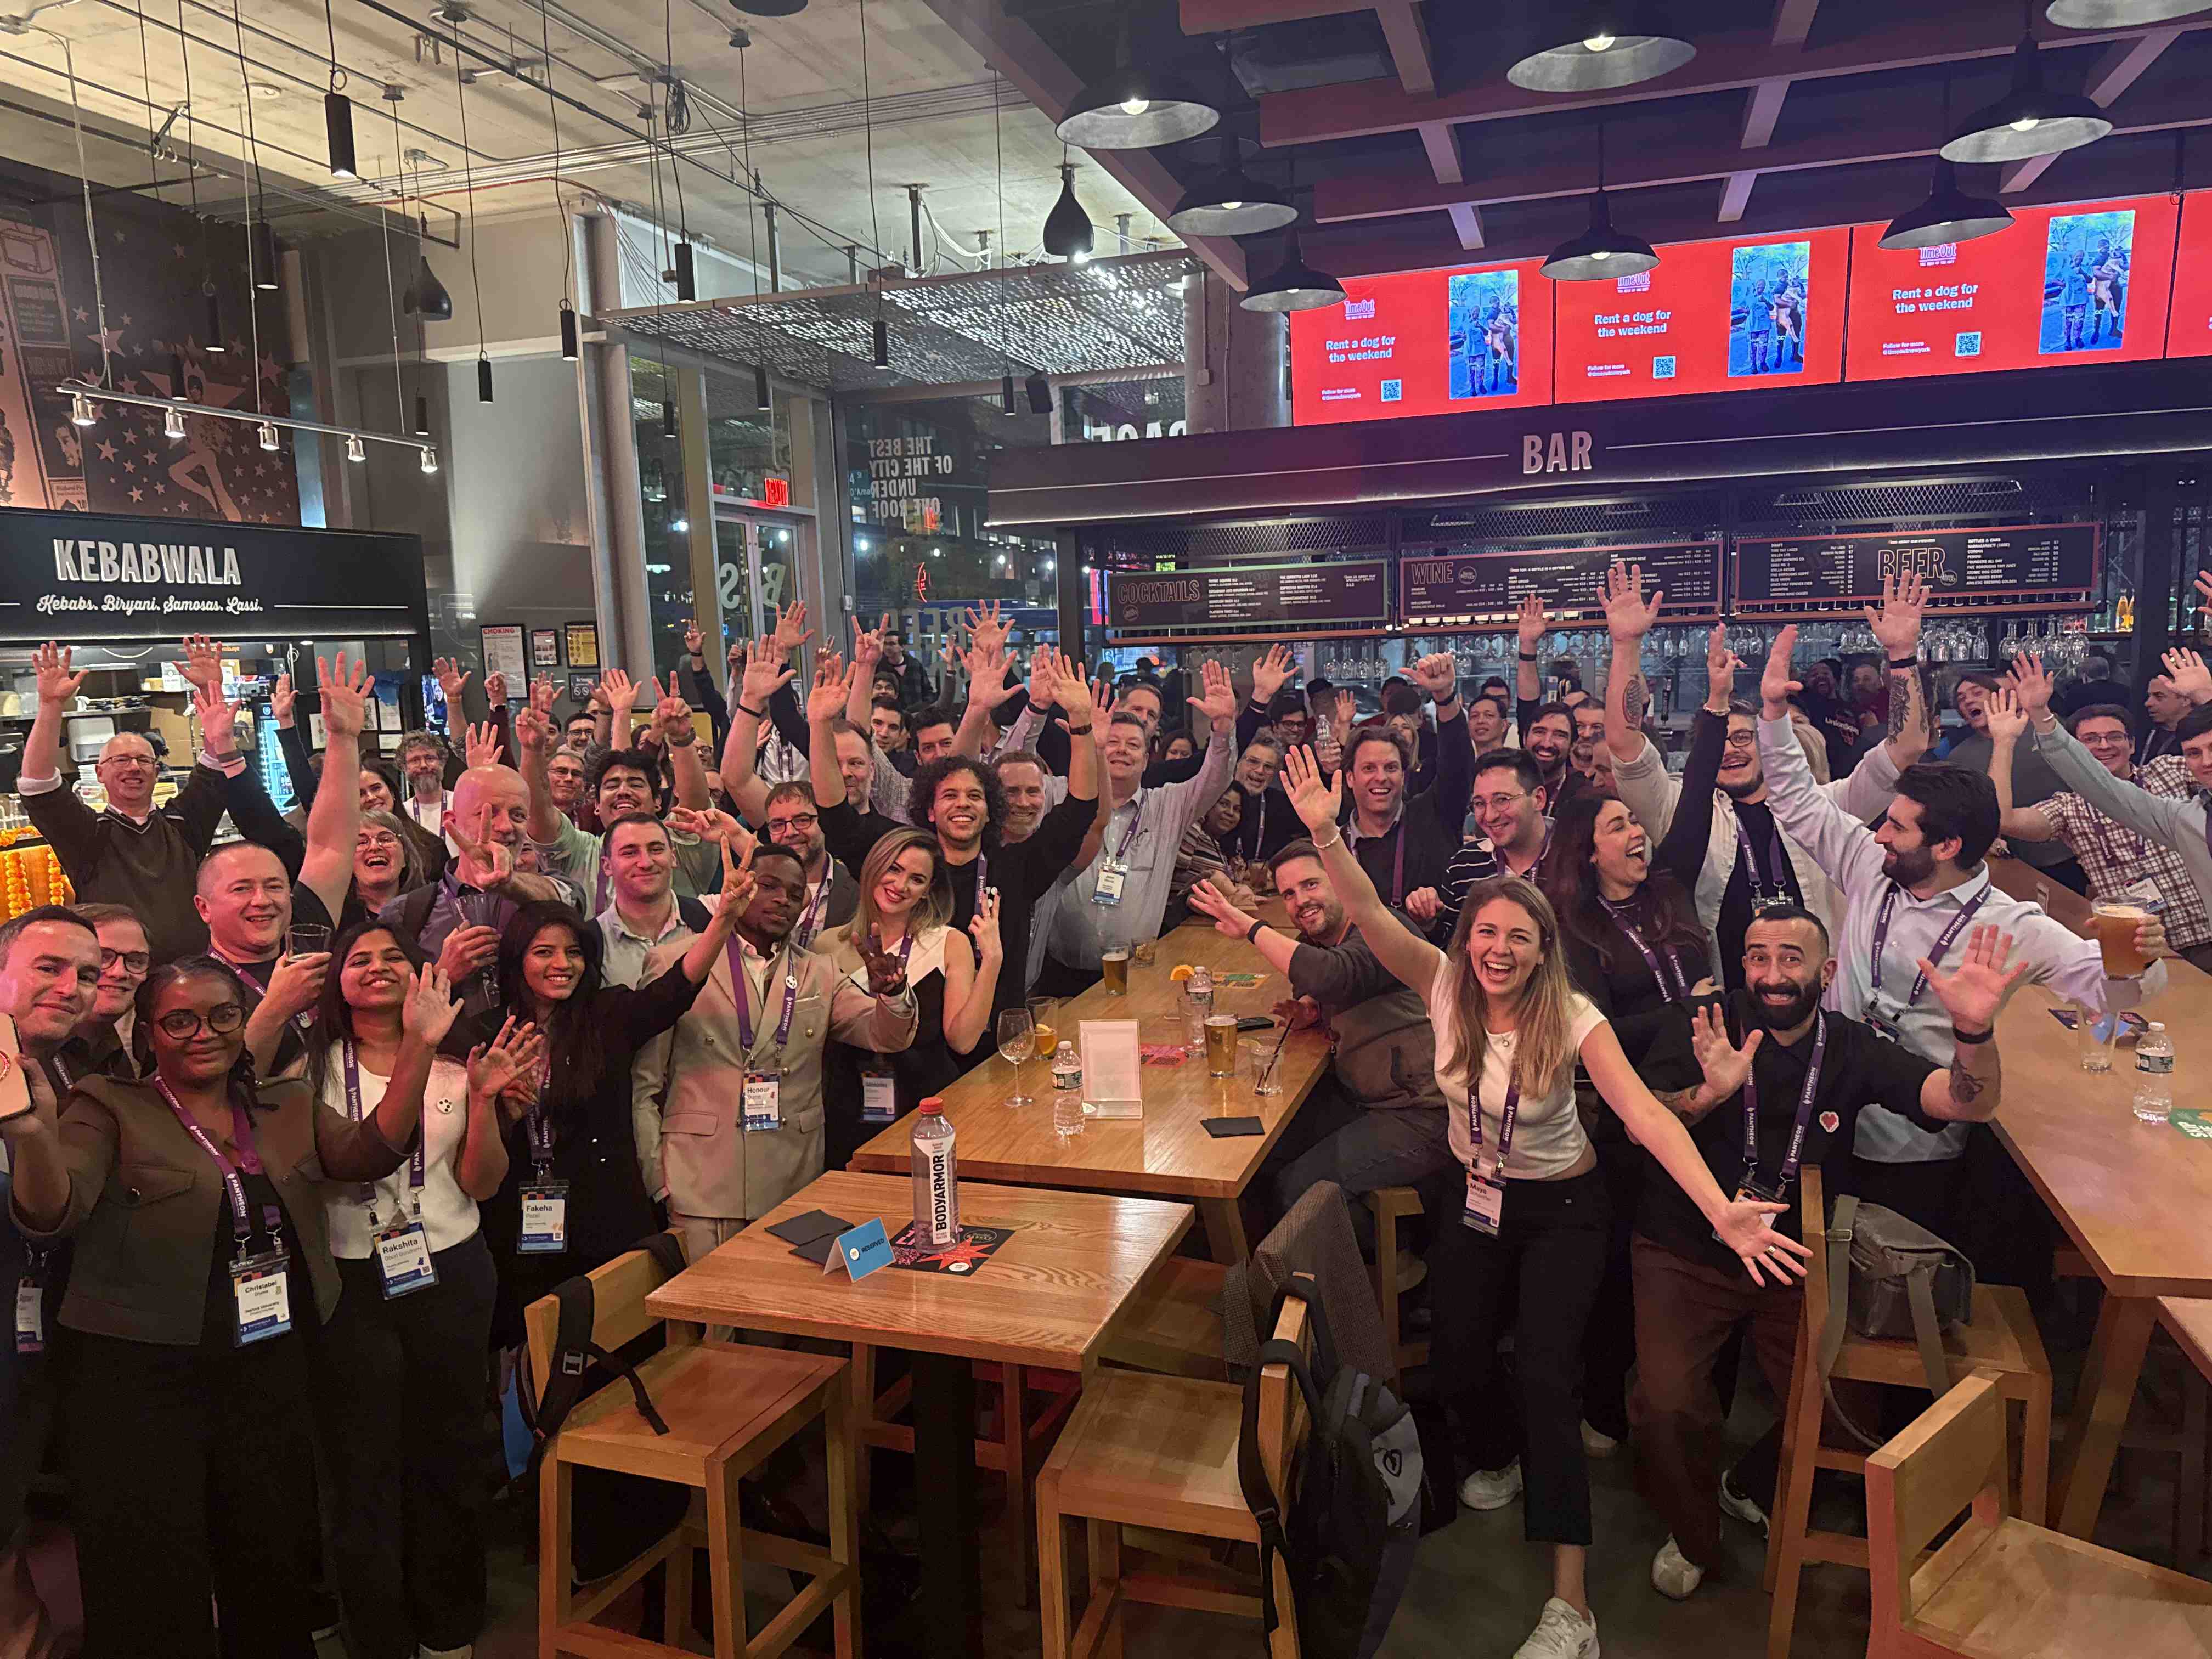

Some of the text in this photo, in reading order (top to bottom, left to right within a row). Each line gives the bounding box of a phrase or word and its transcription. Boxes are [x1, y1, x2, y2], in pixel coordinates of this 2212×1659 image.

[1893, 284, 1978, 300] Rent a dog for
[1895, 297, 1973, 313] the weekend
[1594, 314, 1620, 325] Rent
[1633, 311, 1654, 323] dog
[1656, 310, 1671, 320] for
[1598, 323, 1667, 337] the weekend
[1326, 340, 1349, 351] Rent
[1361, 337, 1379, 348] dog
[1381, 335, 1396, 346] for
[1329, 348, 1392, 363] the weekend
[1523, 431, 1592, 474] BAR
[53, 539, 241, 585] KEBABWALA
[1411, 562, 1454, 584] WINE
[1878, 548, 1945, 580] BEER
[36, 594, 263, 616] Kebabs. Biryani. Samosas. Lassi.
[1118, 579, 1200, 604] COCKTAILS
[1944, 914, 1966, 941] PANTHEON
[1673, 960, 1685, 987] PANTHEON
[780, 1001, 794, 1032] PANTHEON
[1804, 1067, 1816, 1099] PANTHEON
[1504, 1111, 1514, 1142] PANTHEON
[194, 1129, 220, 1156] PANTHEON
[1790, 1125, 1803, 1157] PANTHEON
[232, 1179, 246, 1217] PANTHEON
[933, 1154, 947, 1231] BODYARMOR
[382, 1239, 418, 1254] Rakshita
[861, 1238, 885, 1253] RESERVED
